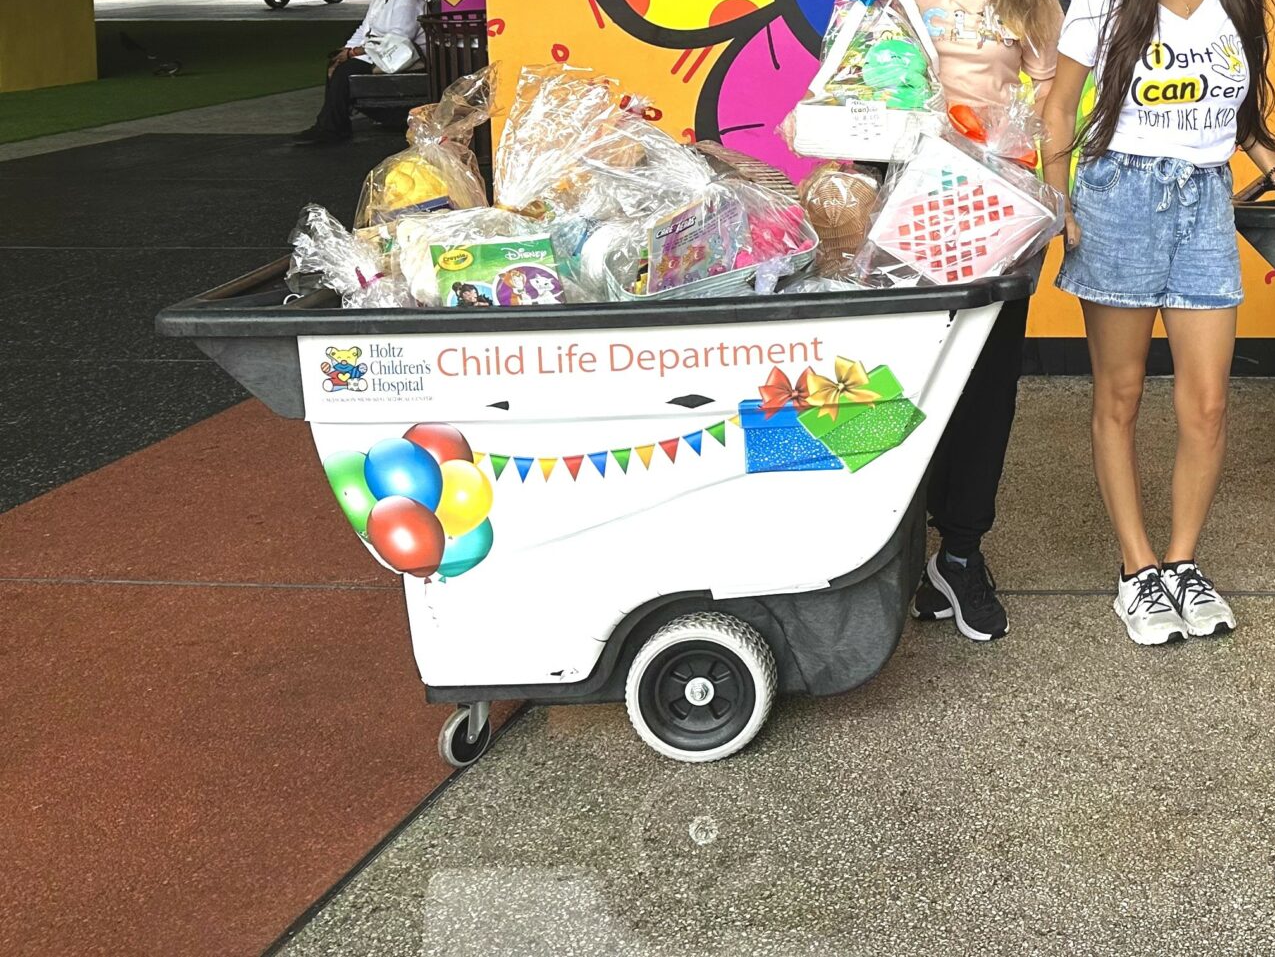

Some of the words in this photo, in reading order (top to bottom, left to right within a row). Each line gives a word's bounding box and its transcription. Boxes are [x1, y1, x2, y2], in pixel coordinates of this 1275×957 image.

[1131, 74, 1244, 106] (can)cer
[1138, 109, 1171, 129] FIGHT
[1177, 108, 1198, 131] LIKE
[1204, 107, 1212, 129] A
[1215, 108, 1235, 129] KID
[370, 343, 403, 358] Holtz
[437, 346, 524, 376] Child
[537, 344, 597, 374] Life
[608, 337, 824, 377] Department
[370, 359, 432, 375] Children's
[372, 377, 424, 395] Hospital
